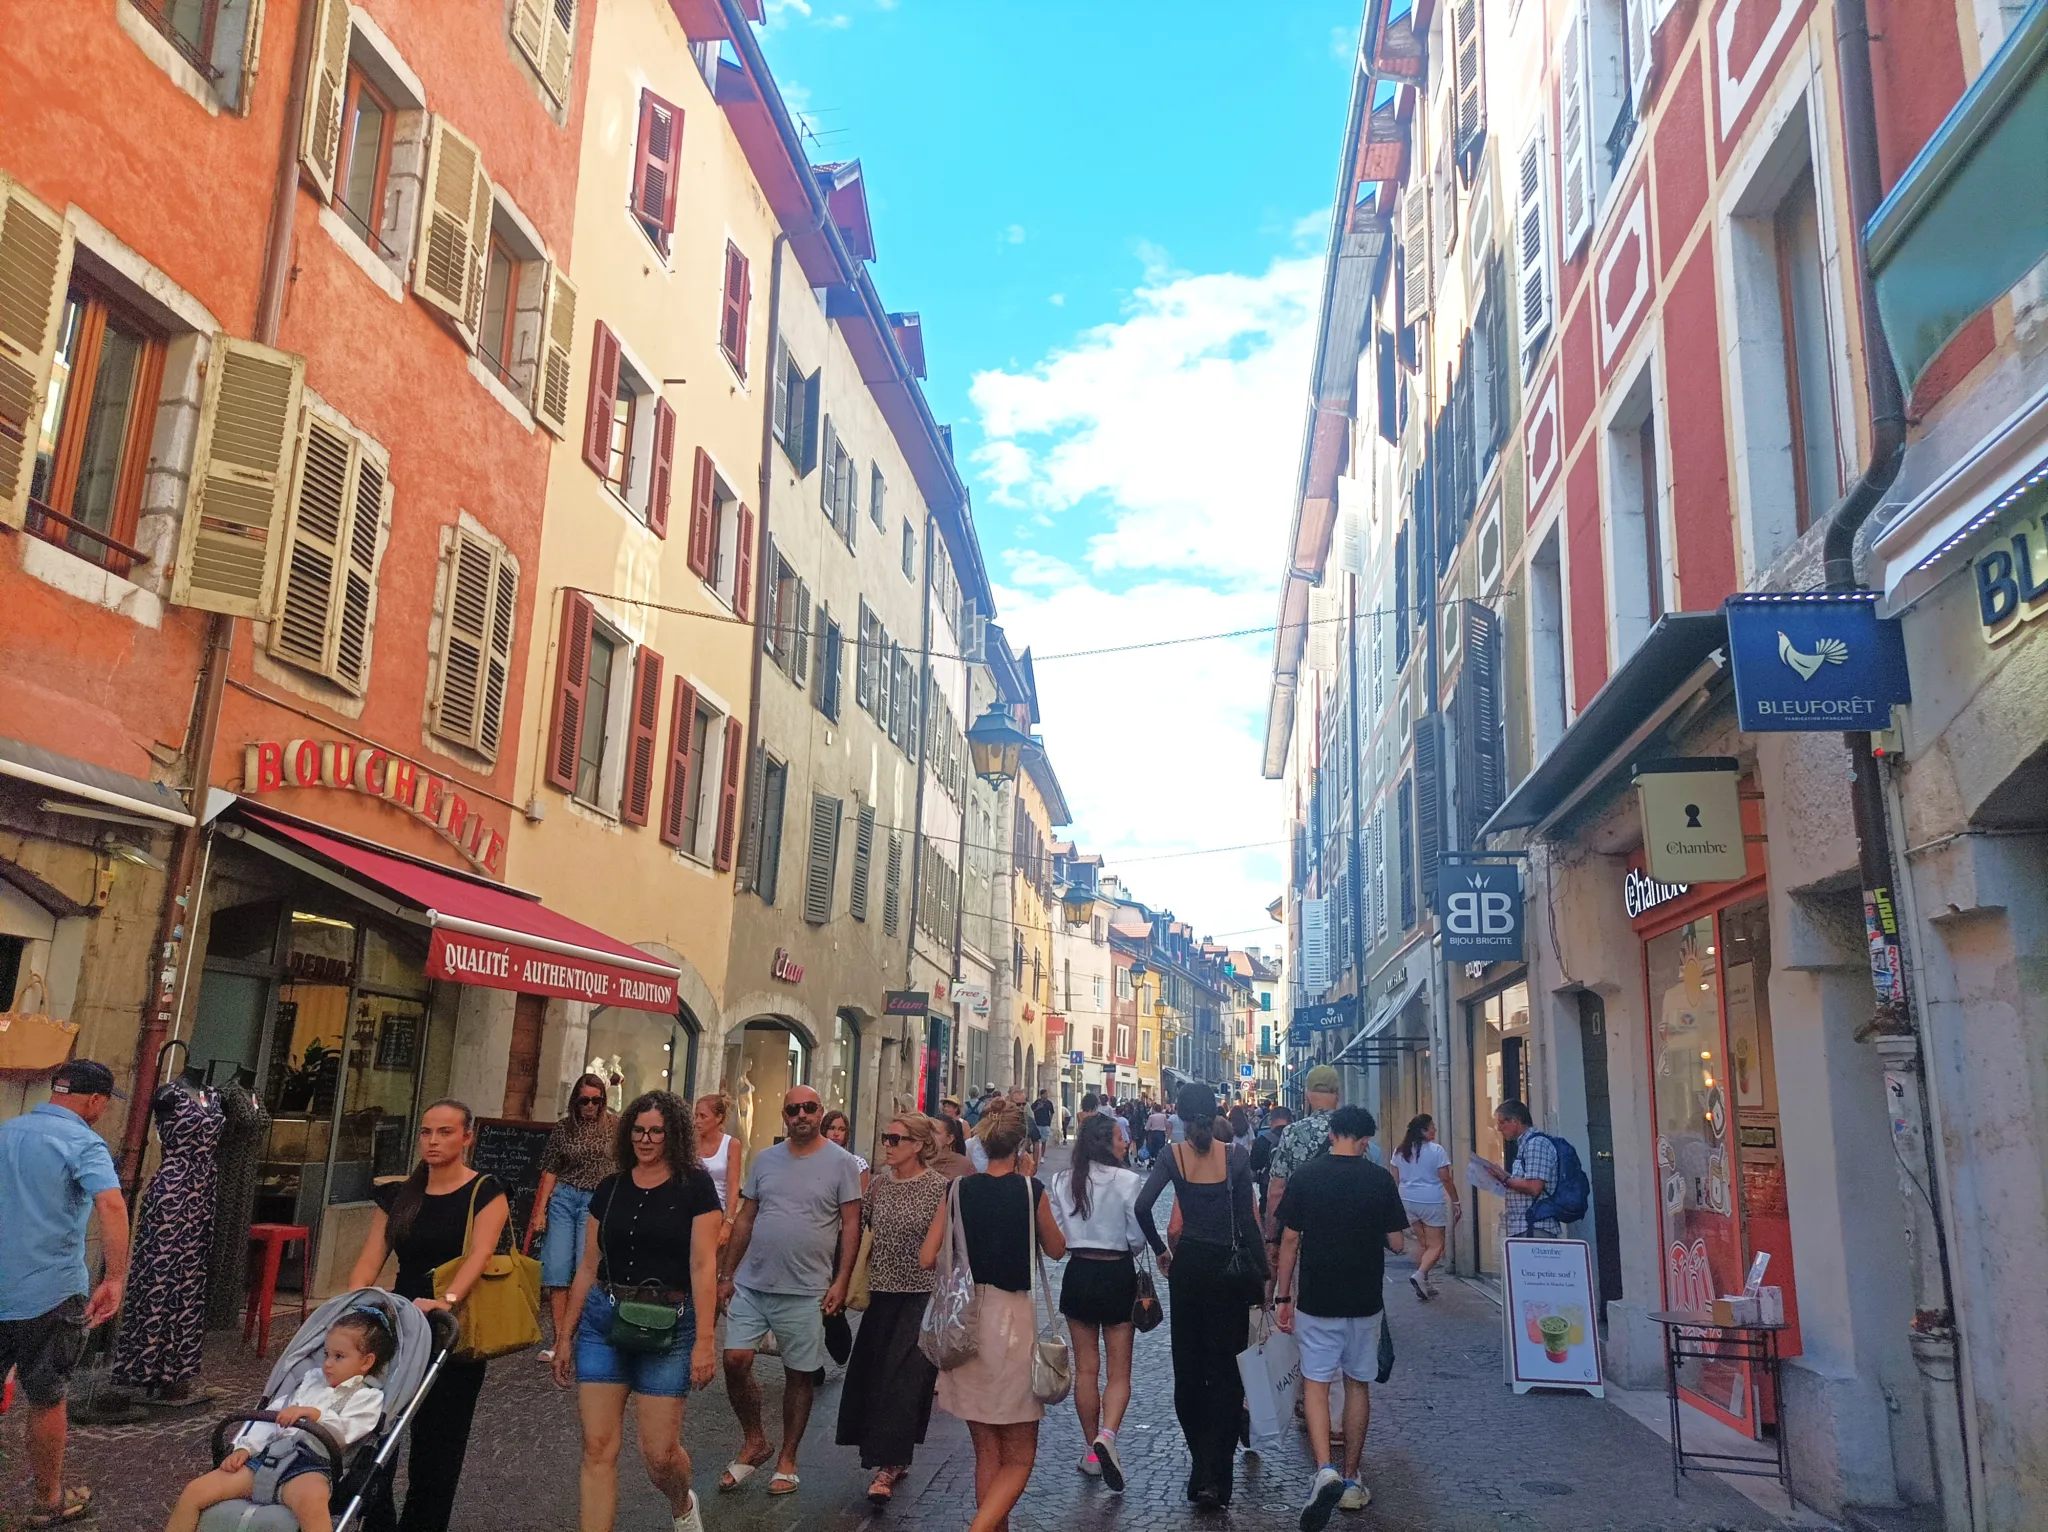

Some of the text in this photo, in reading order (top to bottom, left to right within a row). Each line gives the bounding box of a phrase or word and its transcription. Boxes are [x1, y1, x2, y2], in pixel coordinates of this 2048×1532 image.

[1974, 512, 2048, 627] BL
[1757, 696, 1876, 714] BLEUFORÊT
[246, 740, 505, 875] BOUCHERIE
[1666, 841, 1727, 855] Chambre
[1449, 937, 1512, 946] BIJOU BRIGITTE
[445, 943, 672, 1005] QUALITÉ AUTHENTIQUE TRADITION
[954, 988, 980, 998] free
[889, 998, 923, 1010] Etam
[1320, 1013, 1344, 1026] avril
[1521, 1269, 1535, 1277] Une
[1537, 1271, 1556, 1279] petite
[1558, 1270, 1571, 1278] soif
